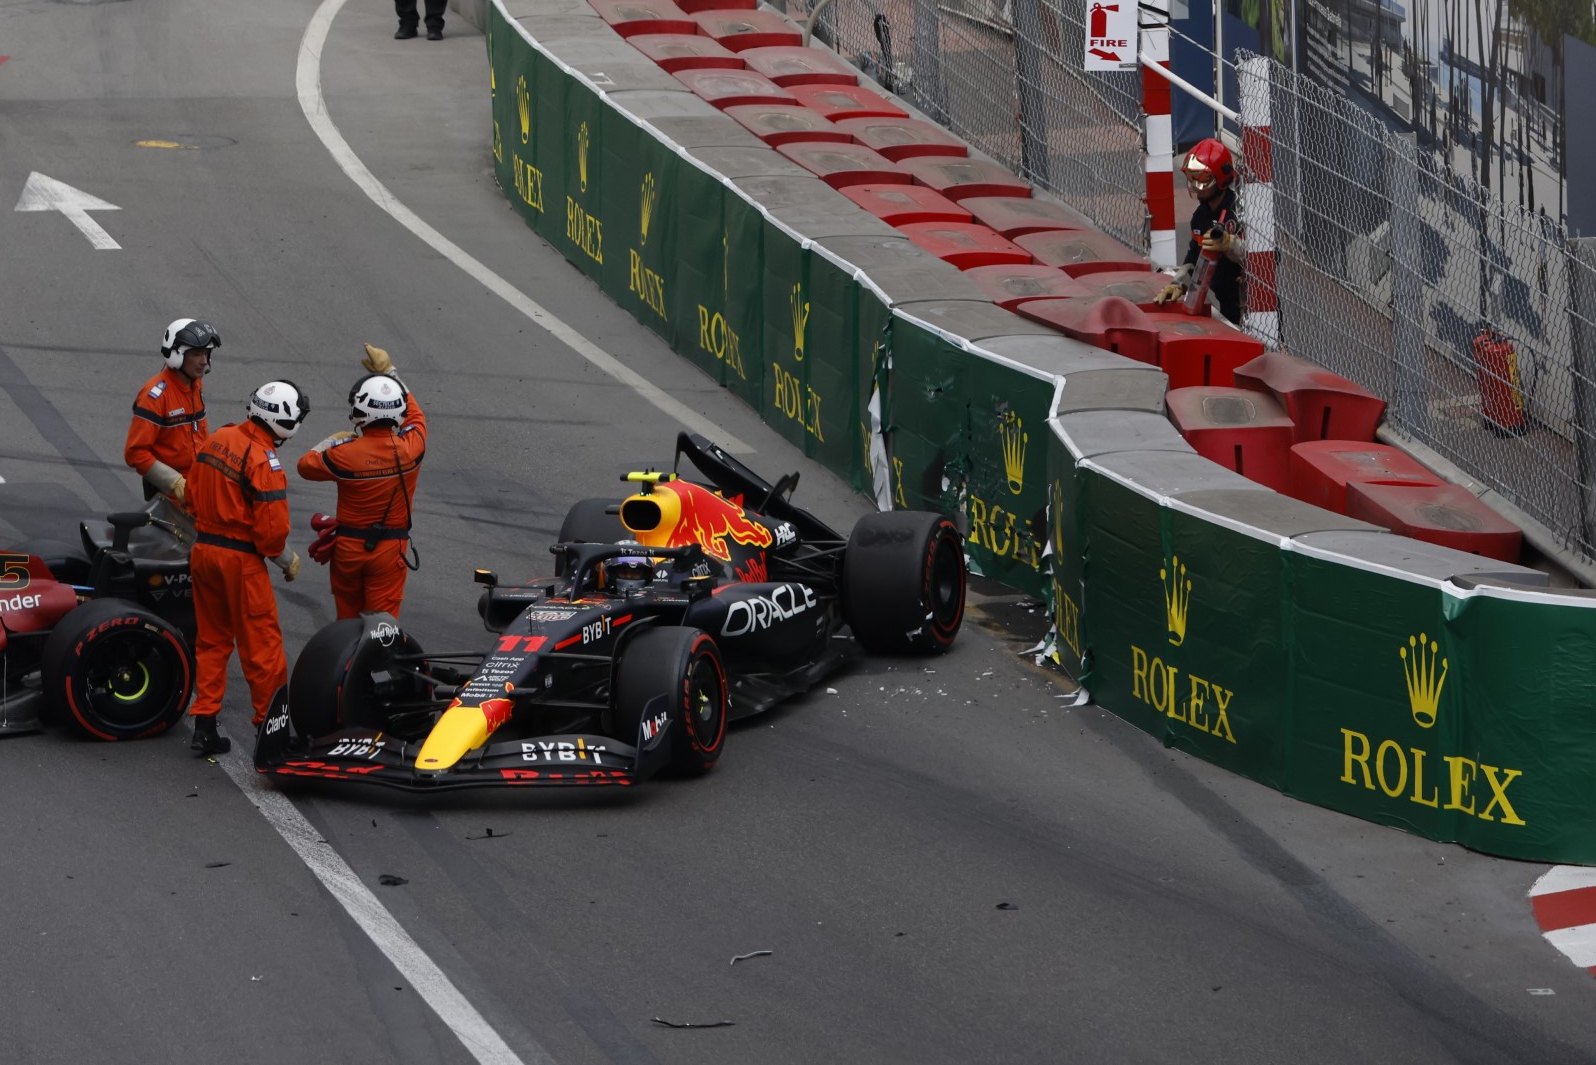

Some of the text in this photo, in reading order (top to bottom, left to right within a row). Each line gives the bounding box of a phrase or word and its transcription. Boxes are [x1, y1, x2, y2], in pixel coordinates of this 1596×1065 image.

[1090, 39, 1128, 48] FIRE
[566, 195, 604, 266] ROLEX
[164, 573, 193, 586] V-Po
[720, 582, 817, 637] ORACLE
[86, 616, 140, 642] ZERO
[582, 614, 612, 645] BYBIT
[498, 635, 549, 653] 11
[485, 661, 521, 669] citrix
[1131, 644, 1237, 744] ROLEX
[266, 714, 288, 736] Claro
[521, 737, 607, 765] BYBIT
[1340, 728, 1526, 826] ROLEX
